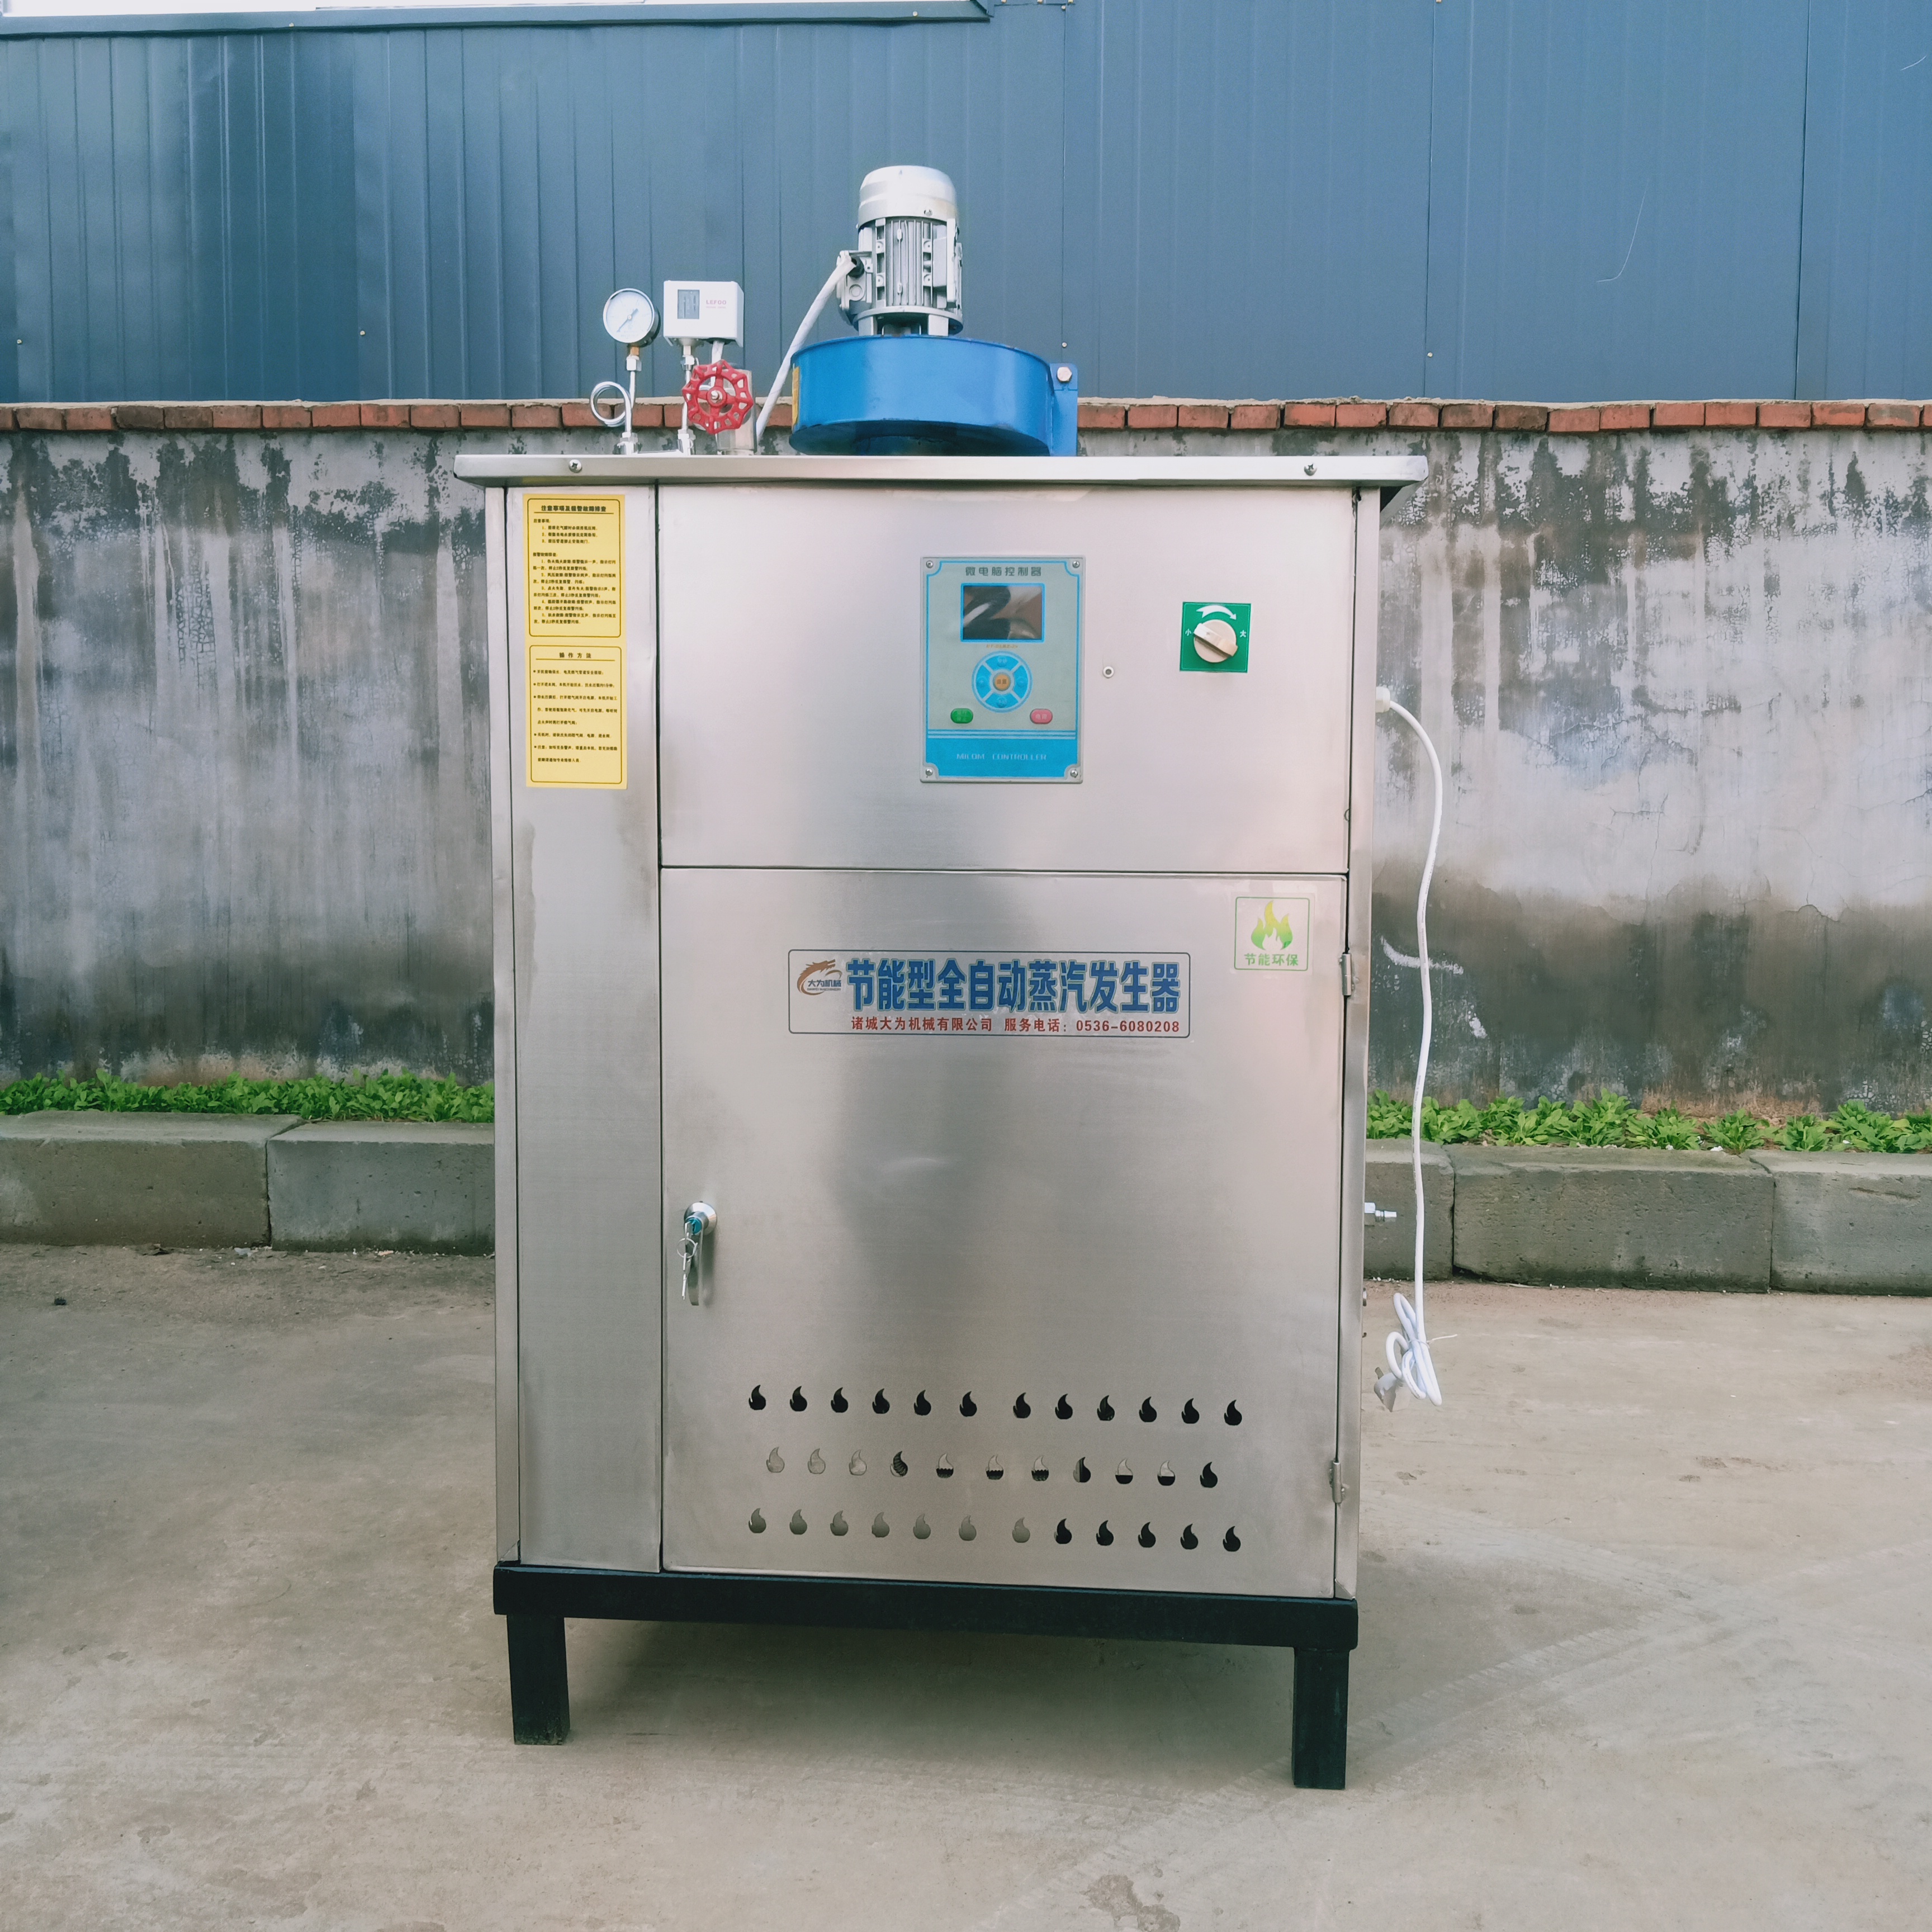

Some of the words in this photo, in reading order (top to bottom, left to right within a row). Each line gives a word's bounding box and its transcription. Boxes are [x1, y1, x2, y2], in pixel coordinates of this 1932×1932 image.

[965, 566, 1042, 577] 微电脑控制器
[1244, 953, 1299, 967] 节能环保
[808, 979, 842, 987] 大为机械
[846, 958, 1180, 1015] 节能型全自动蒸汽发生器
[851, 1016, 993, 1032] 诸城大为机械有限公司
